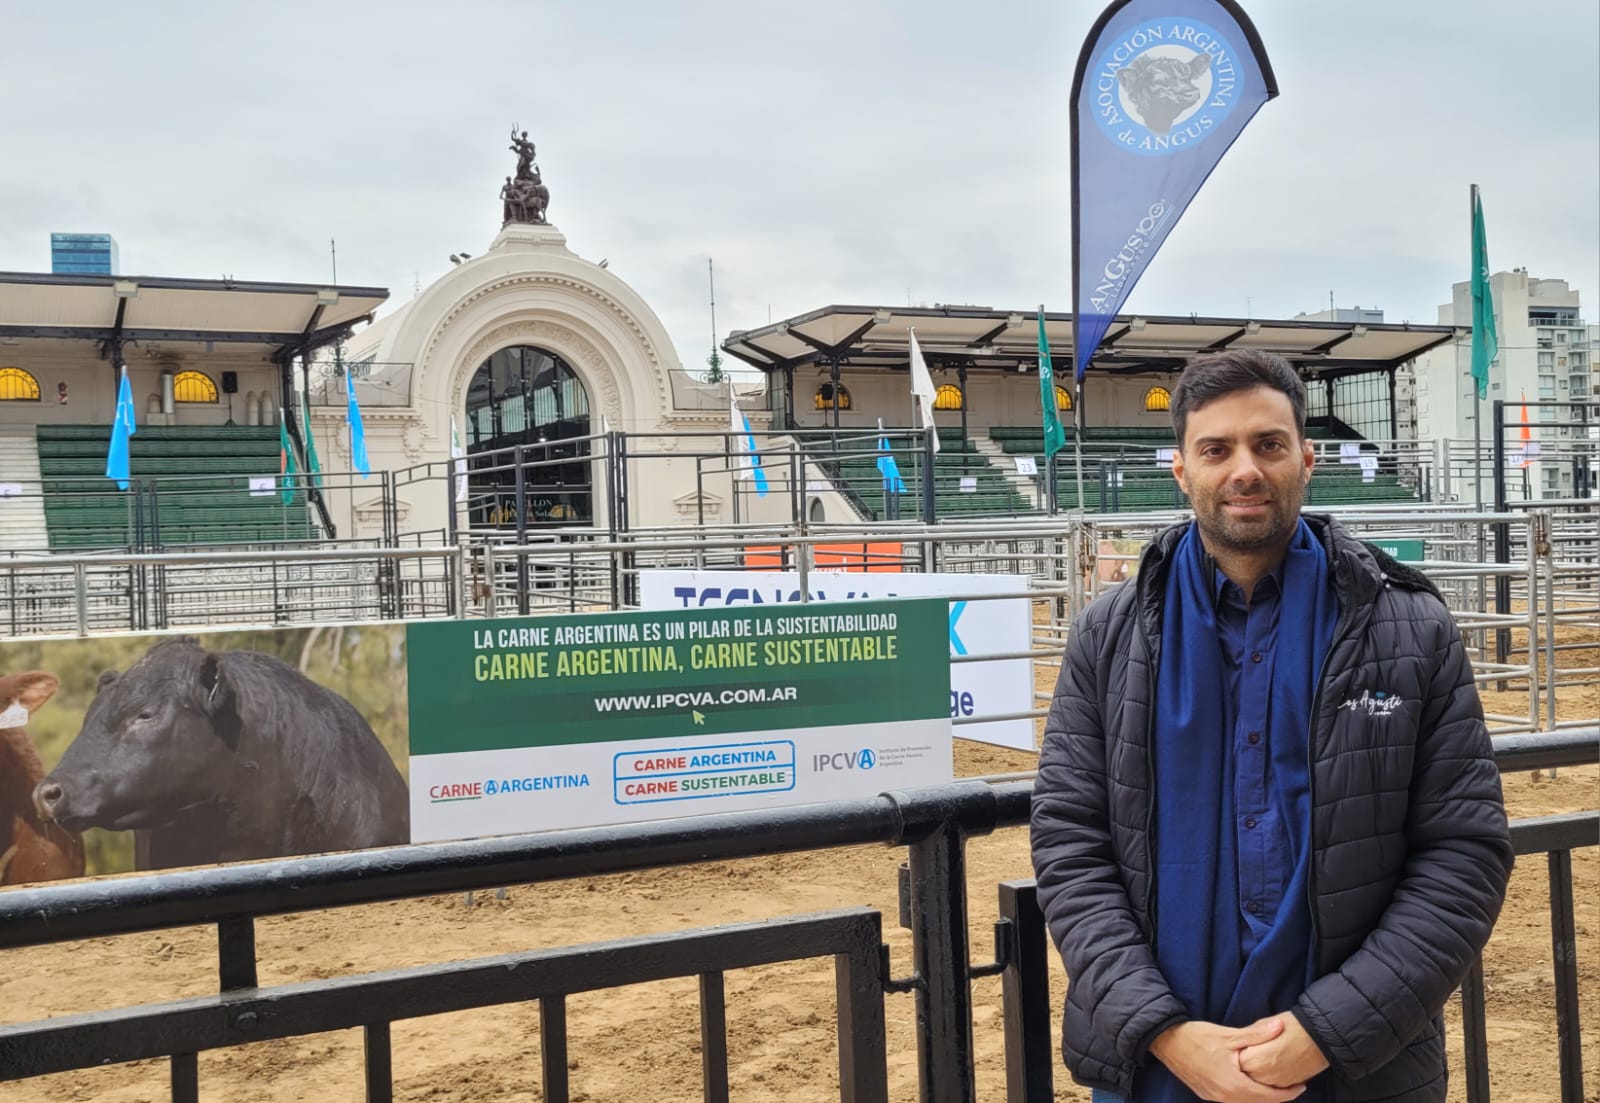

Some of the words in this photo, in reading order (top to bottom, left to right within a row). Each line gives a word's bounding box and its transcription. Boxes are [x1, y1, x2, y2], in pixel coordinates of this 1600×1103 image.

[1097, 25, 1163, 126] ASOCIACIÓN
[1167, 25, 1236, 108] ARGENTINA
[1118, 129, 1136, 145] de
[1138, 115, 1214, 150] ANGUS
[1021, 463, 1033, 472] 23
[474, 630, 494, 649] LA
[498, 627, 549, 648] CARNE
[554, 623, 639, 646] ARGENTINA
[643, 622, 661, 641] ES
[665, 621, 684, 640] UN
[689, 618, 730, 640] PILAR
[734, 618, 752, 637] DE
[756, 617, 773, 636] LA
[777, 613, 897, 635] SUSTENTABILIDAD
[474, 651, 549, 681] CARNE
[556, 646, 684, 677] ARGENTINA,
[690, 641, 758, 670] CARNE
[764, 635, 897, 666] SUSTENTABLE
[594, 686, 798, 712] WWW.IPCVA.COM.AR
[634, 756, 686, 772] CARNE
[690, 750, 776, 768] ARGENTINA
[813, 748, 876, 772] IPCVA
[429, 782, 481, 798] CARNE
[500, 774, 590, 793] ARGENTINA
[625, 780, 678, 796] CARNE
[681, 772, 785, 791] SUSTENTABLE
